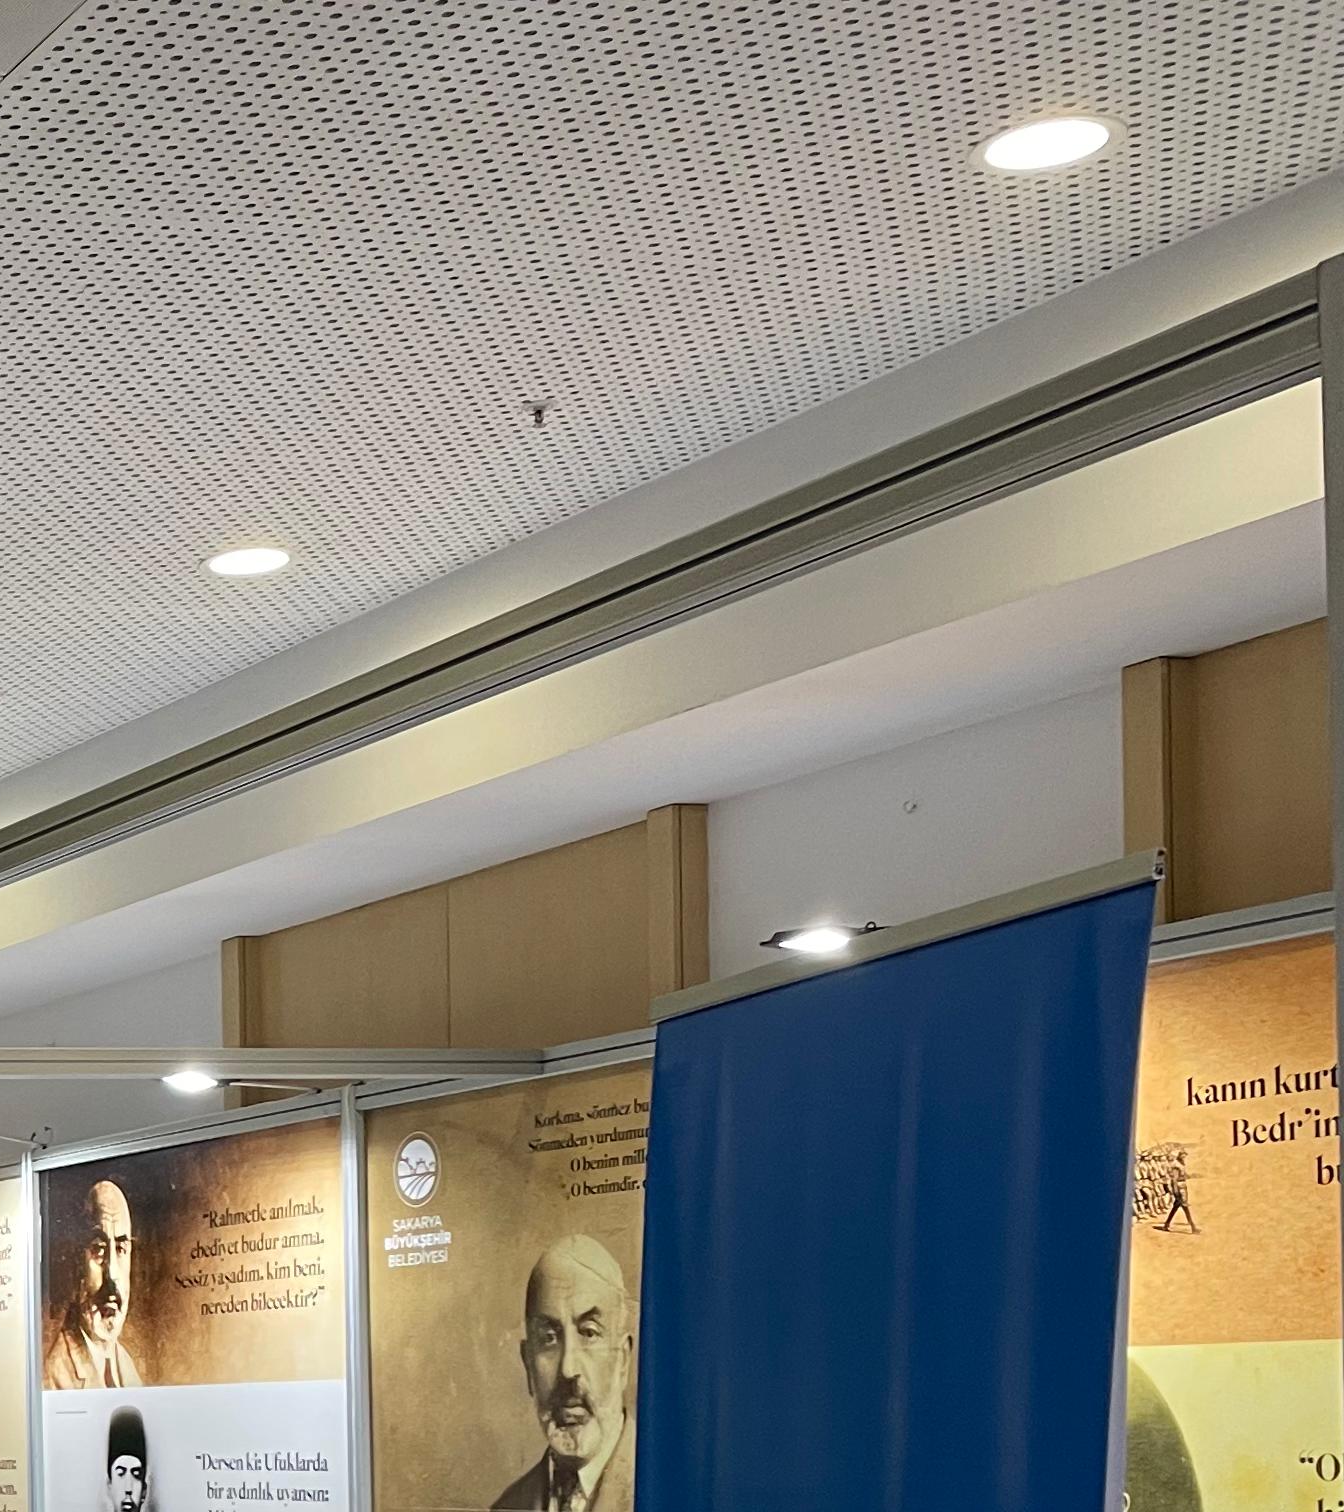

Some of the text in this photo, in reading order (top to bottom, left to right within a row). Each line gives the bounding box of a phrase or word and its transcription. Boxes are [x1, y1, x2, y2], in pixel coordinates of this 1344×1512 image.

[1186, 1076, 1266, 1106] kanın
[392, 1215, 443, 1232] SAKARYA
[241, 1232, 279, 1253] budur
[266, 1261, 291, 1280] kim
[206, 1481, 225, 1500] bir
